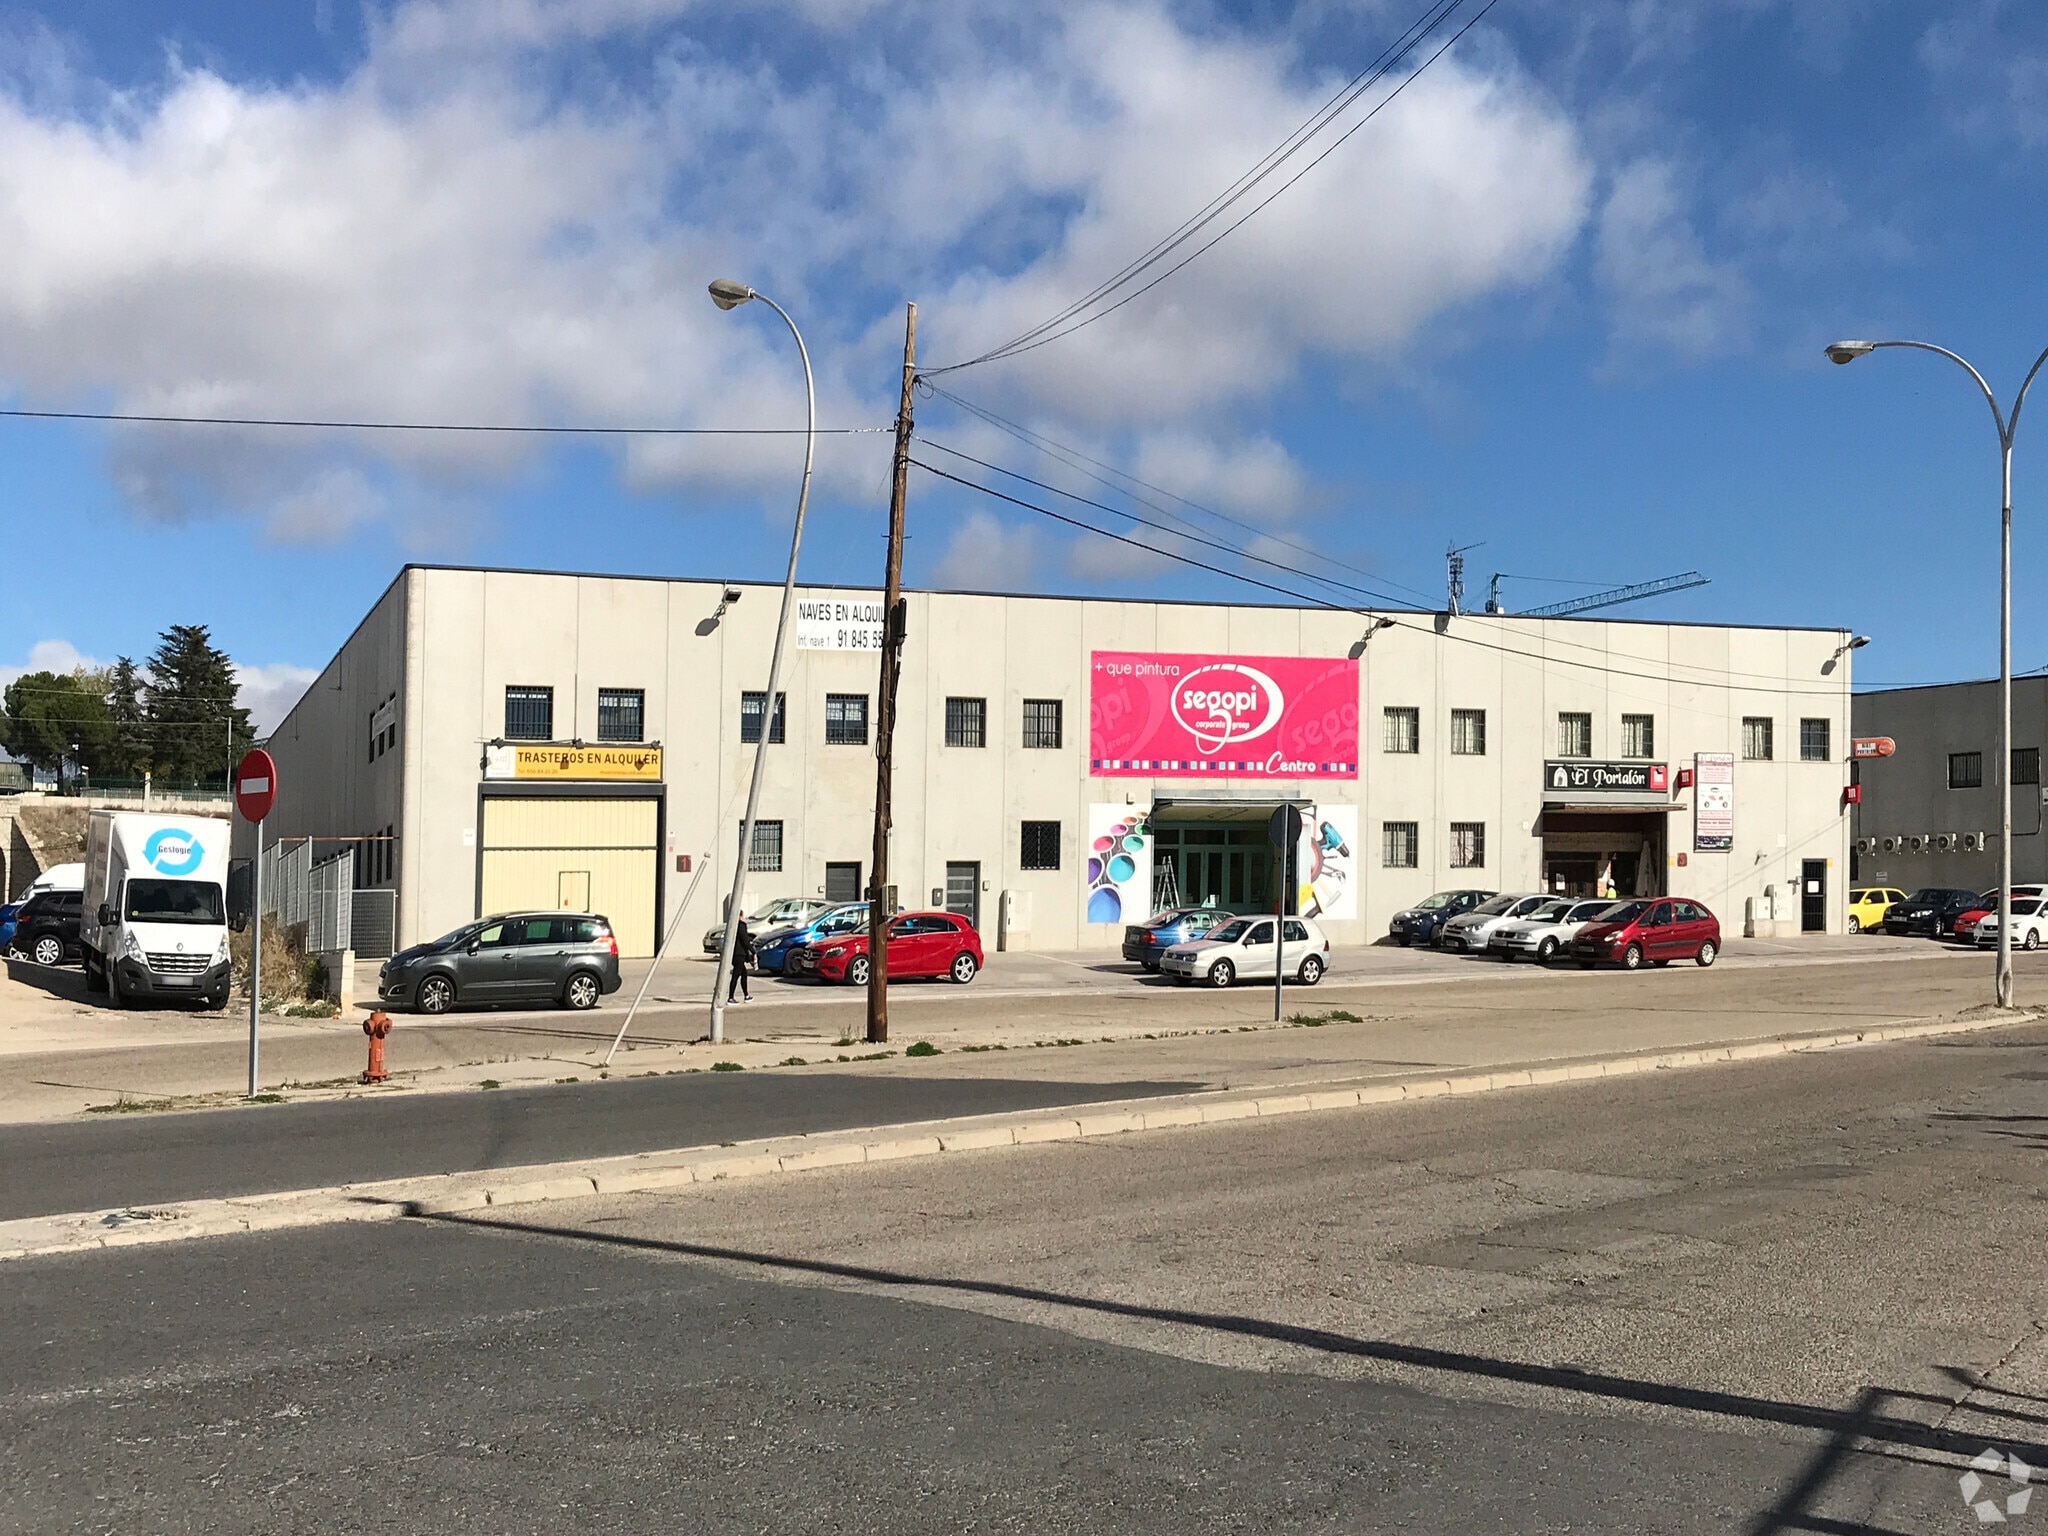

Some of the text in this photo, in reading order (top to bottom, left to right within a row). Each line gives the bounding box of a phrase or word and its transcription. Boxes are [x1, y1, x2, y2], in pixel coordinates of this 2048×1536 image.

[799, 603, 885, 622] NAVES EN ALQUIL
[1106, 662, 1132, 677] que
[1136, 661, 1180, 677] pintura
[1183, 684, 1257, 719] segopi
[1195, 721, 1250, 730] corporate group
[518, 752, 584, 764] TRASTEROS
[587, 752, 601, 764] EN
[604, 753, 658, 765] ALQUILER
[1265, 750, 1317, 774] Centro
[1593, 769, 1646, 788] Portalón
